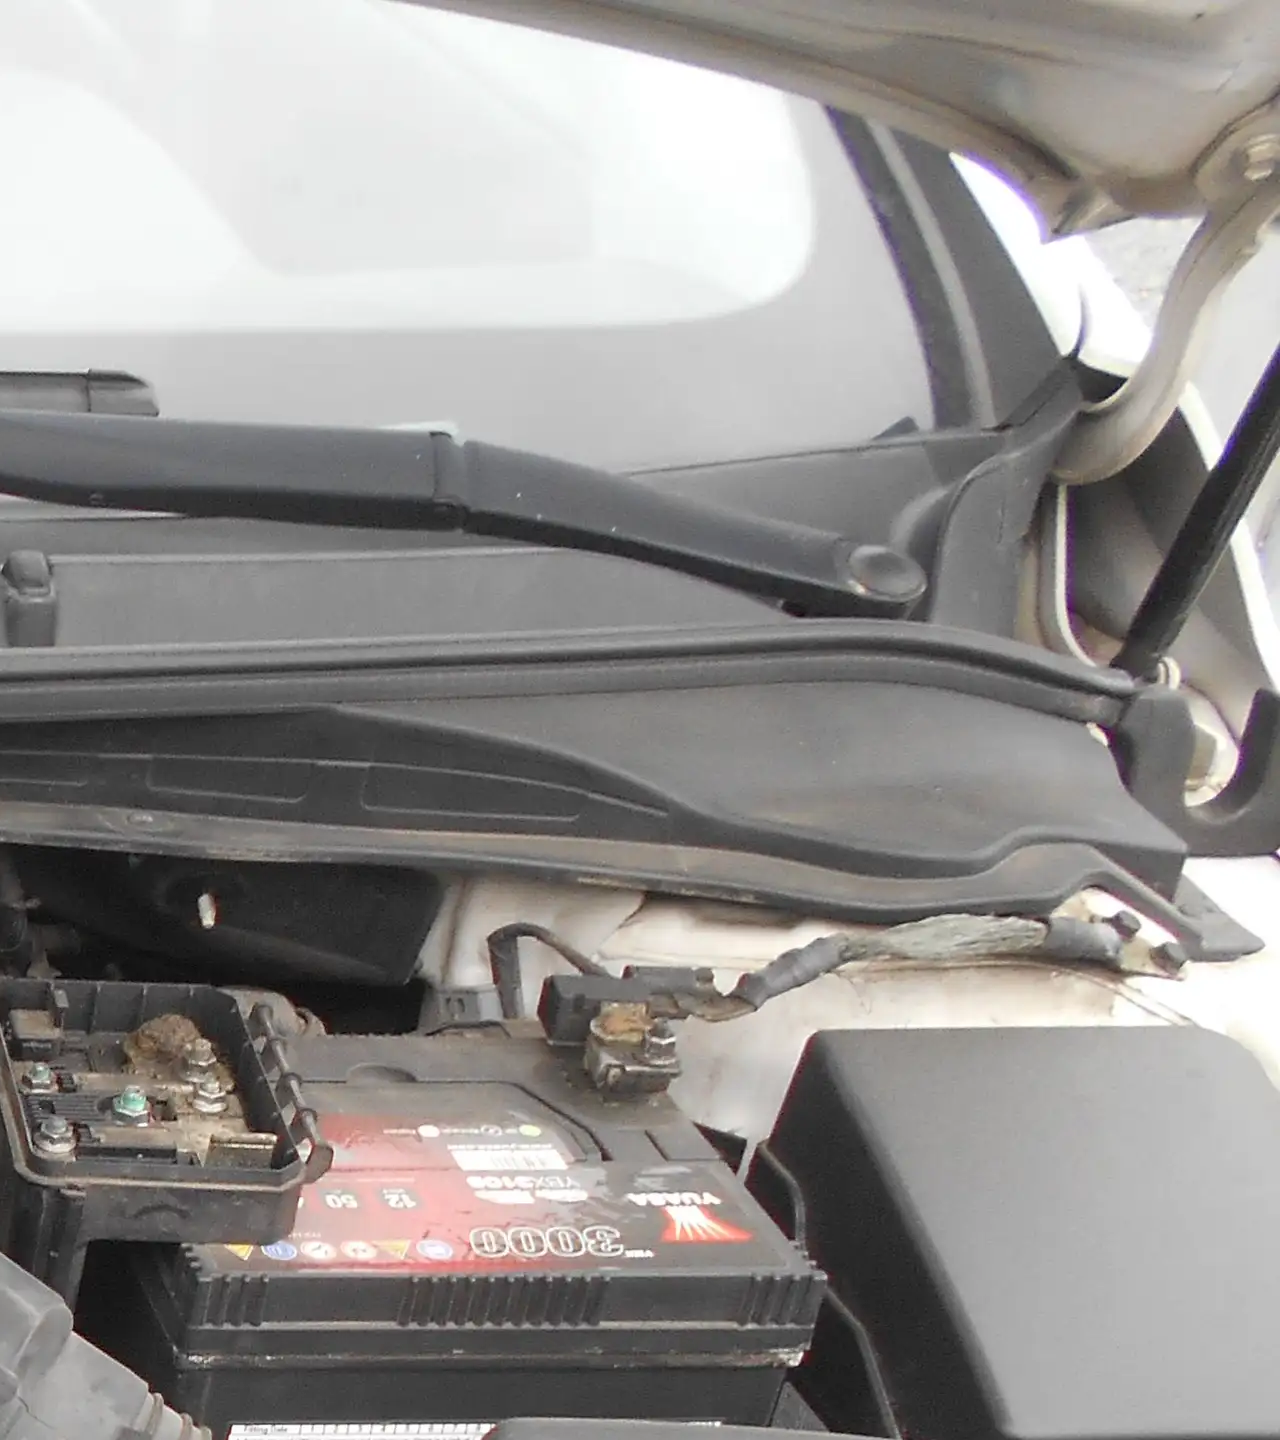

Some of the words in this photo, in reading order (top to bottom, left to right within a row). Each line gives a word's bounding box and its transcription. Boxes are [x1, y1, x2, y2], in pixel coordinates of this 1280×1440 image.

[324, 1194, 358, 1208] 50
[384, 1193, 417, 1209] 12
[627, 1192, 722, 1207] YUASA
[468, 1226, 626, 1259] 3000
